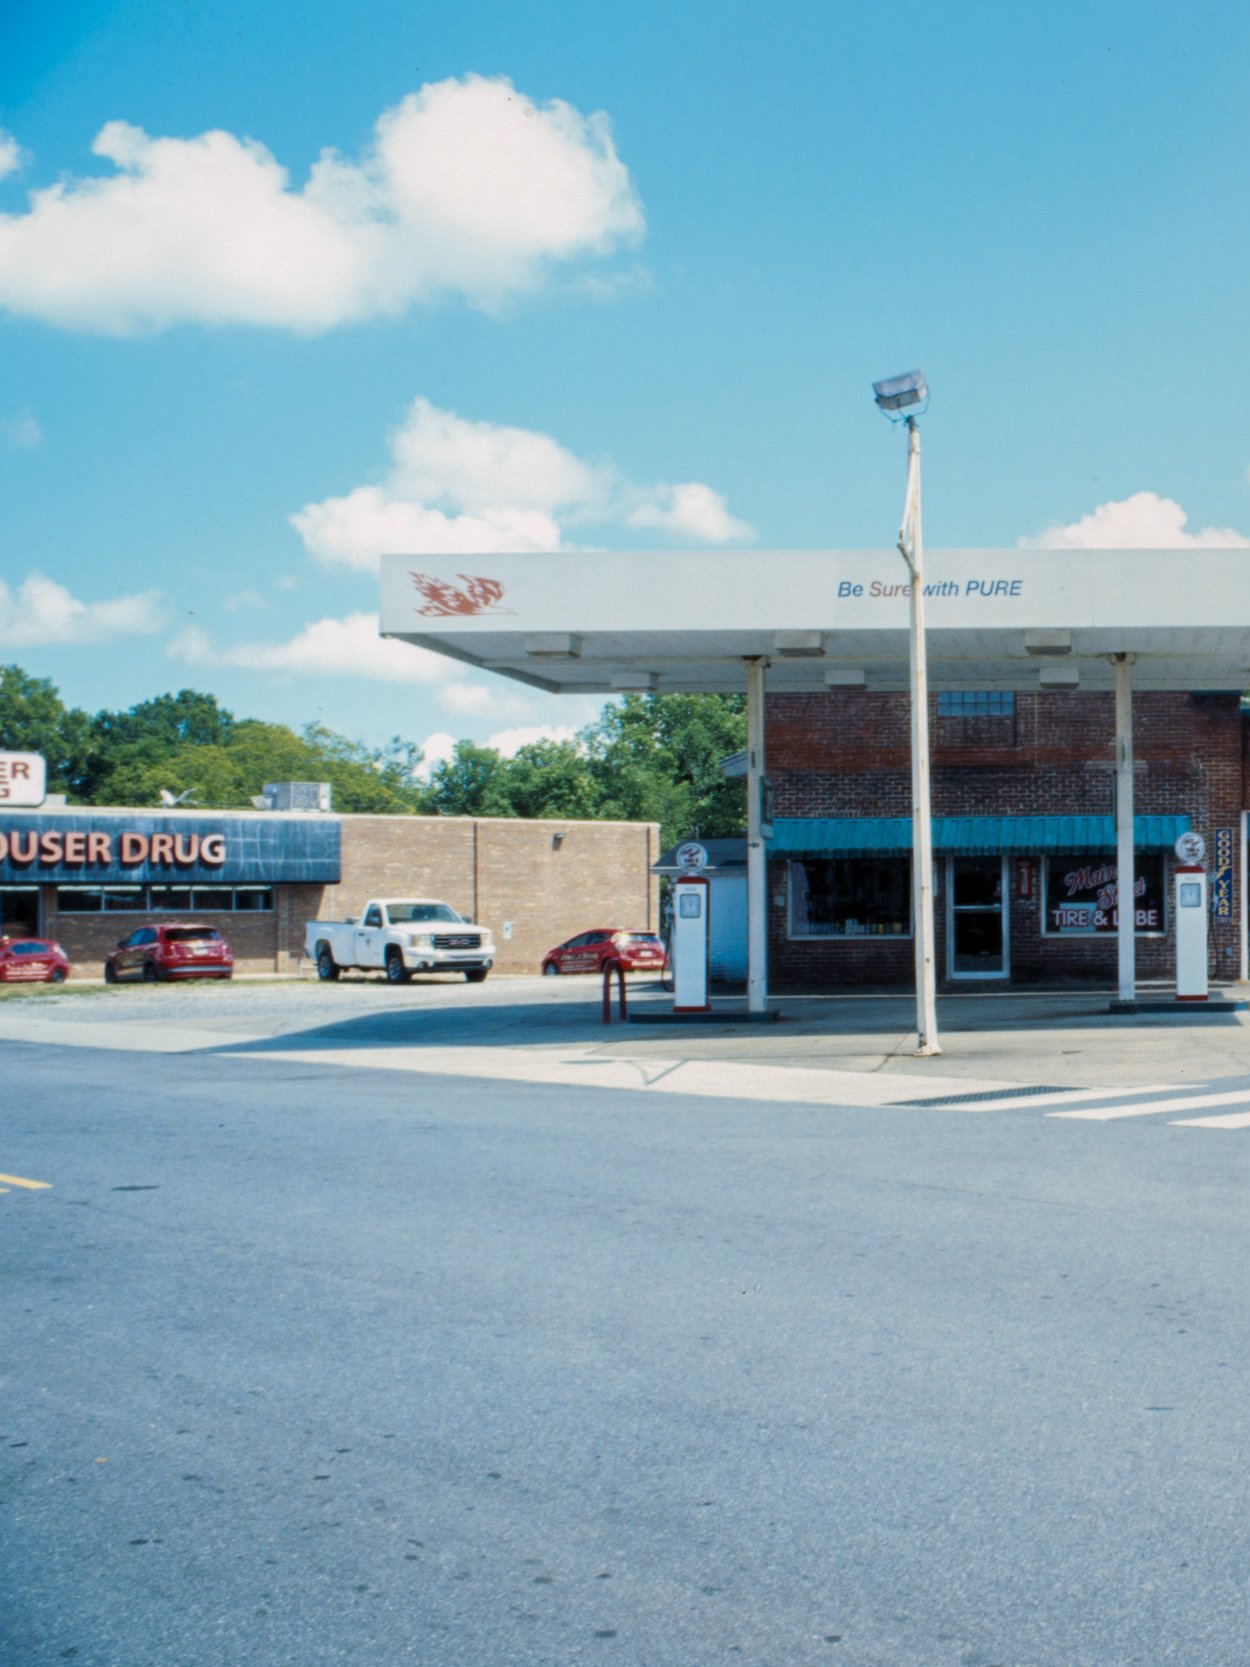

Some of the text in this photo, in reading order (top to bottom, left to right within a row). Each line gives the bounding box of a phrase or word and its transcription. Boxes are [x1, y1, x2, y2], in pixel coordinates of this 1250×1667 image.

[837, 579, 1024, 598] Be Sure with PURE
[120, 833, 227, 864] DRUG
[1063, 864, 1119, 896] Main
[1052, 908, 1158, 926] TIRE & LBE
